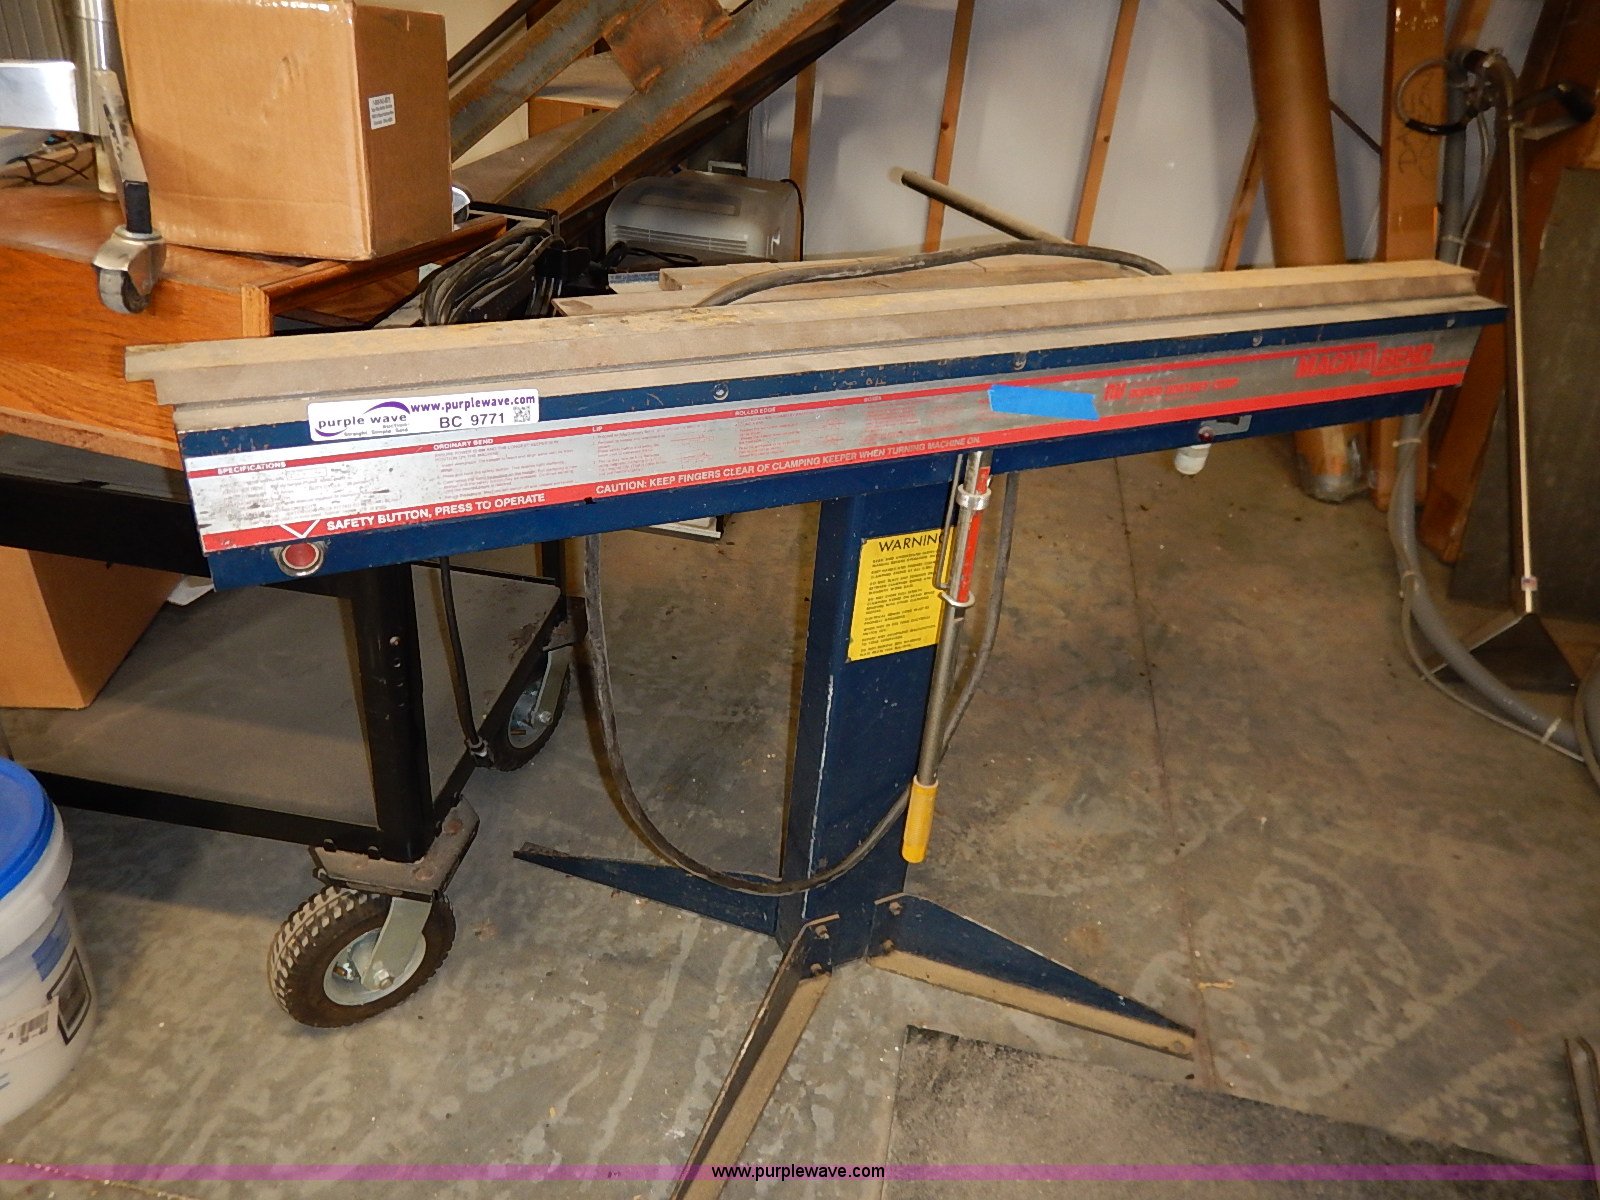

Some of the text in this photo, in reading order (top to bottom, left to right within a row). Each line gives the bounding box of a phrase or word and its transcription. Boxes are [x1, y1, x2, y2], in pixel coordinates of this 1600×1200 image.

[410, 395, 535, 413] www.purplewave.com
[735, 408, 759, 416] ROLLED
[318, 414, 407, 429] purple wave
[440, 412, 504, 428] BC 9771
[433, 440, 471, 450] ORDINARY
[217, 461, 286, 475] SPECIFICATIONS
[595, 480, 647, 495] CAUTION:
[649, 476, 676, 487] KEEP
[678, 470, 721, 483] FINGERS
[723, 466, 754, 477] CLEAR
[756, 464, 770, 473] OF
[771, 457, 820, 471] CLAMPING
[822, 452, 857, 464] KEEPER
[859, 449, 885, 459] WHEN
[887, 444, 926, 456] TURNING
[927, 438, 965, 450] MACHINE
[326, 493, 545, 531] SAFETY BUTTON, PRESS TO OPERATE
